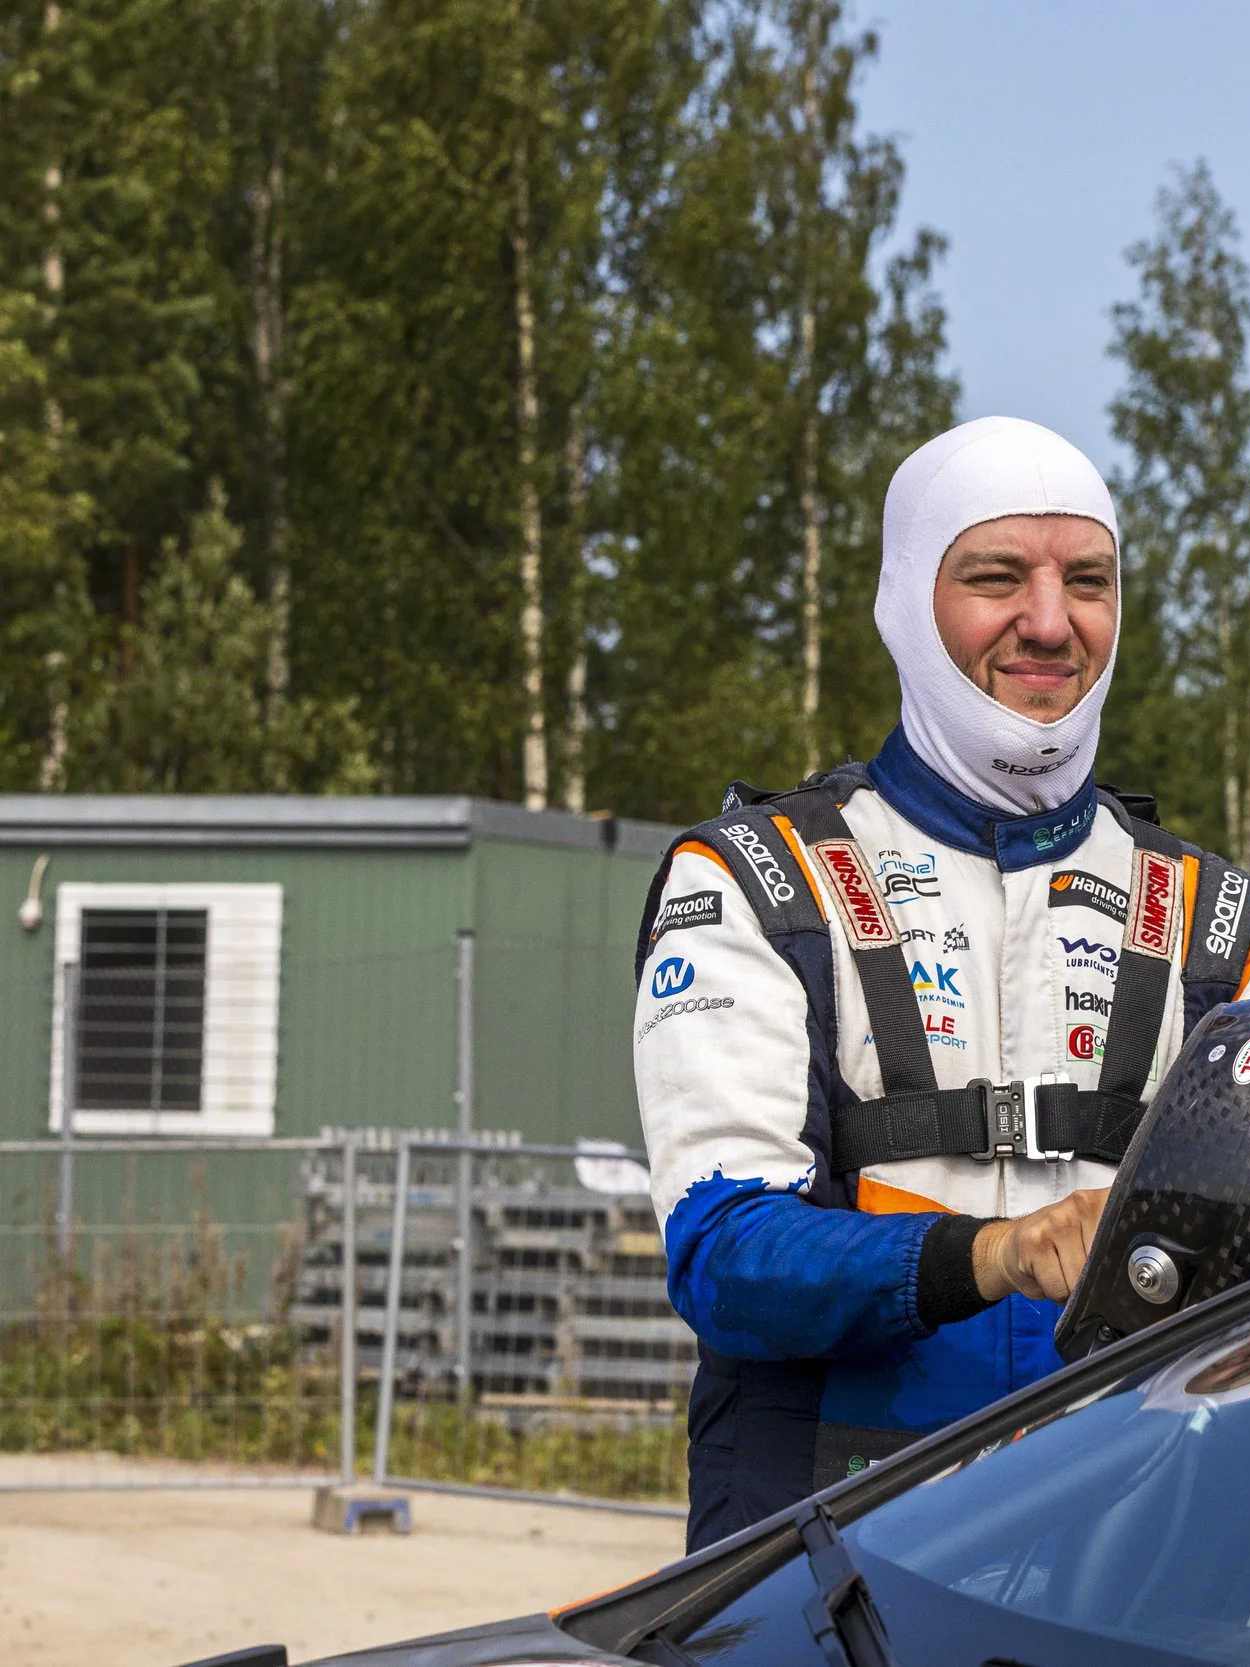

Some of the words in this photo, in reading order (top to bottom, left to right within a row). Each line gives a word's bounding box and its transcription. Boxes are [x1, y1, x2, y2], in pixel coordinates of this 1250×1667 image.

[992, 745, 1079, 776] sparco
[719, 824, 795, 908] sparco
[878, 850, 901, 859] FIA
[825, 850, 883, 936] SIMPSON
[1091, 896, 1117, 915] driving
[1141, 860, 1169, 947] SIMPSON
[684, 912, 717, 923] emotion
[1206, 871, 1248, 959] sparco
[655, 959, 690, 994] W
[1066, 958, 1115, 978] LUBRICANTS
[918, 994, 965, 1009] TAKADEMIN
